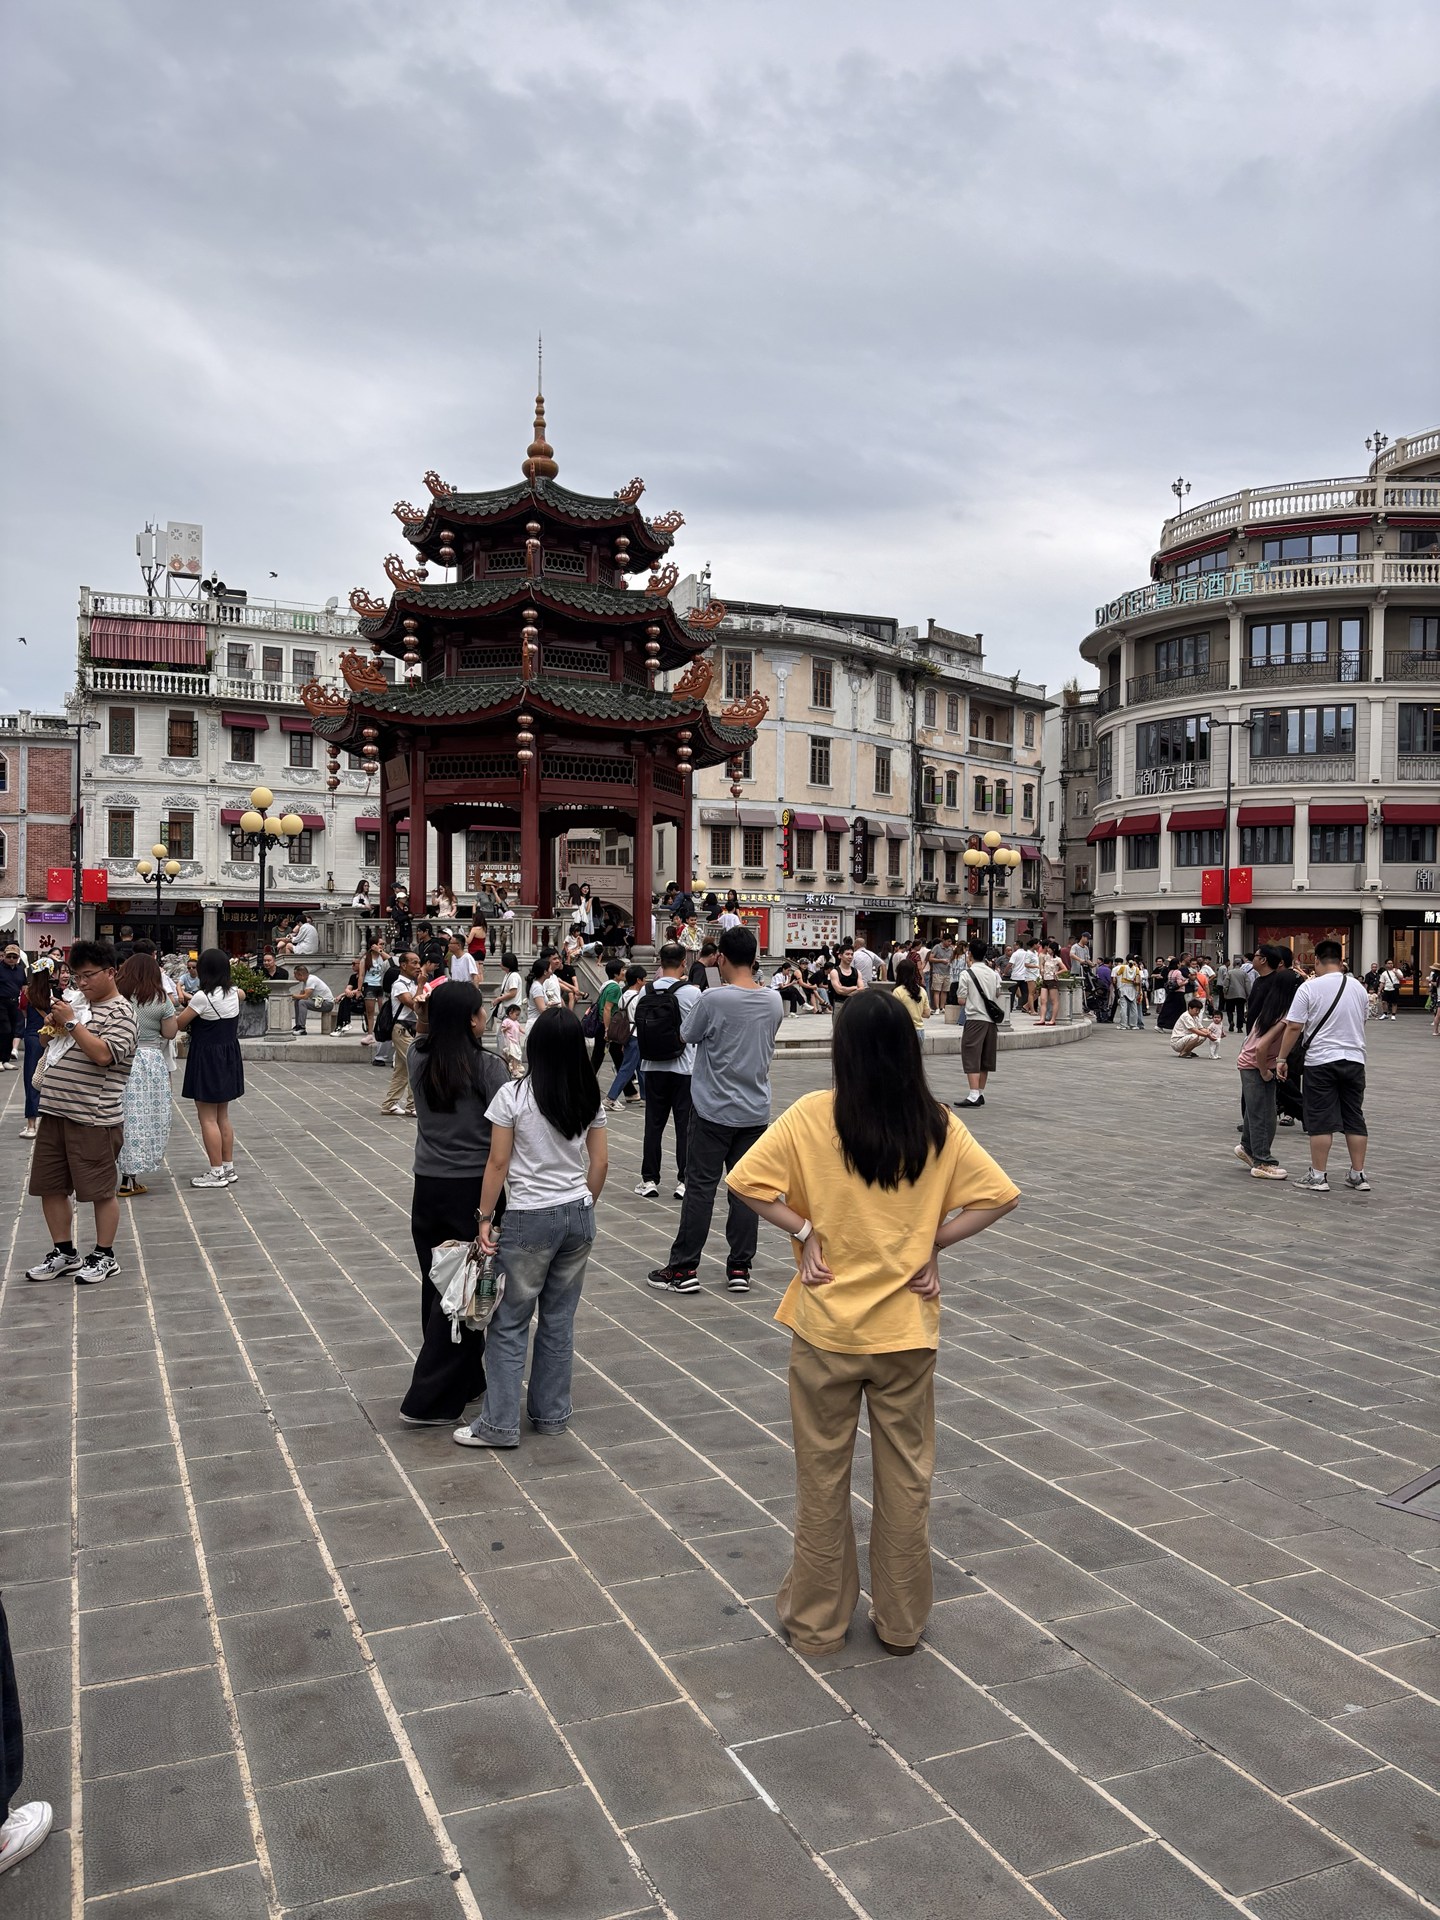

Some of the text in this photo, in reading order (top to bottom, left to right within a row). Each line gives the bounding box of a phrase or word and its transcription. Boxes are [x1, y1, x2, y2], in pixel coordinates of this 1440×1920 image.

[1155, 568, 1255, 608] 皇后酒店
[1136, 763, 1195, 795] 潮宏基
